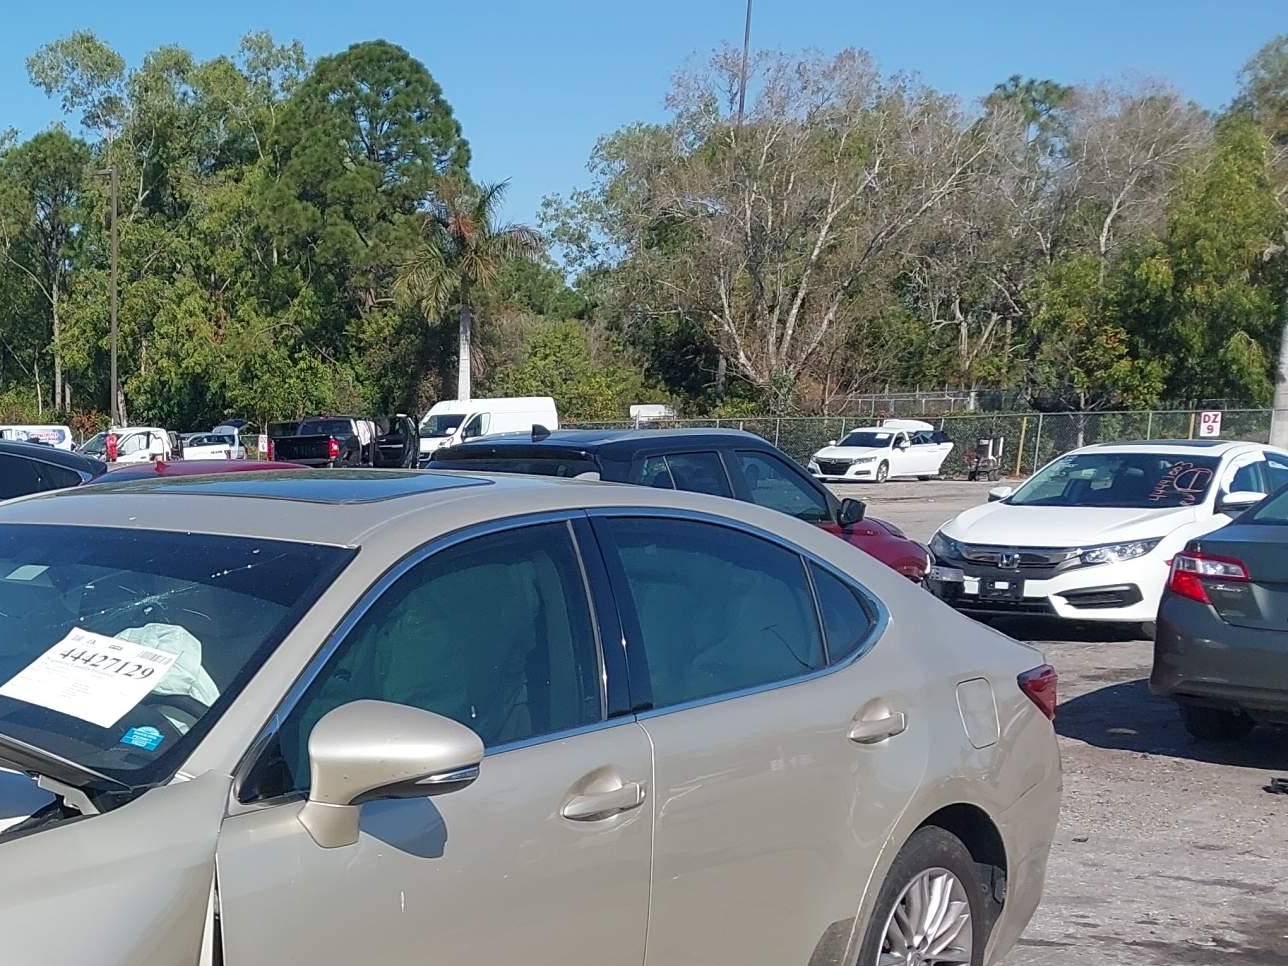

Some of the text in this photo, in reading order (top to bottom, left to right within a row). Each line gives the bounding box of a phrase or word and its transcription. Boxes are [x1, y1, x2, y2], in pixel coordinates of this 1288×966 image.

[1202, 413, 1220, 424] DZ
[1206, 424, 1214, 434] 9
[59, 647, 155, 680] 44427129
